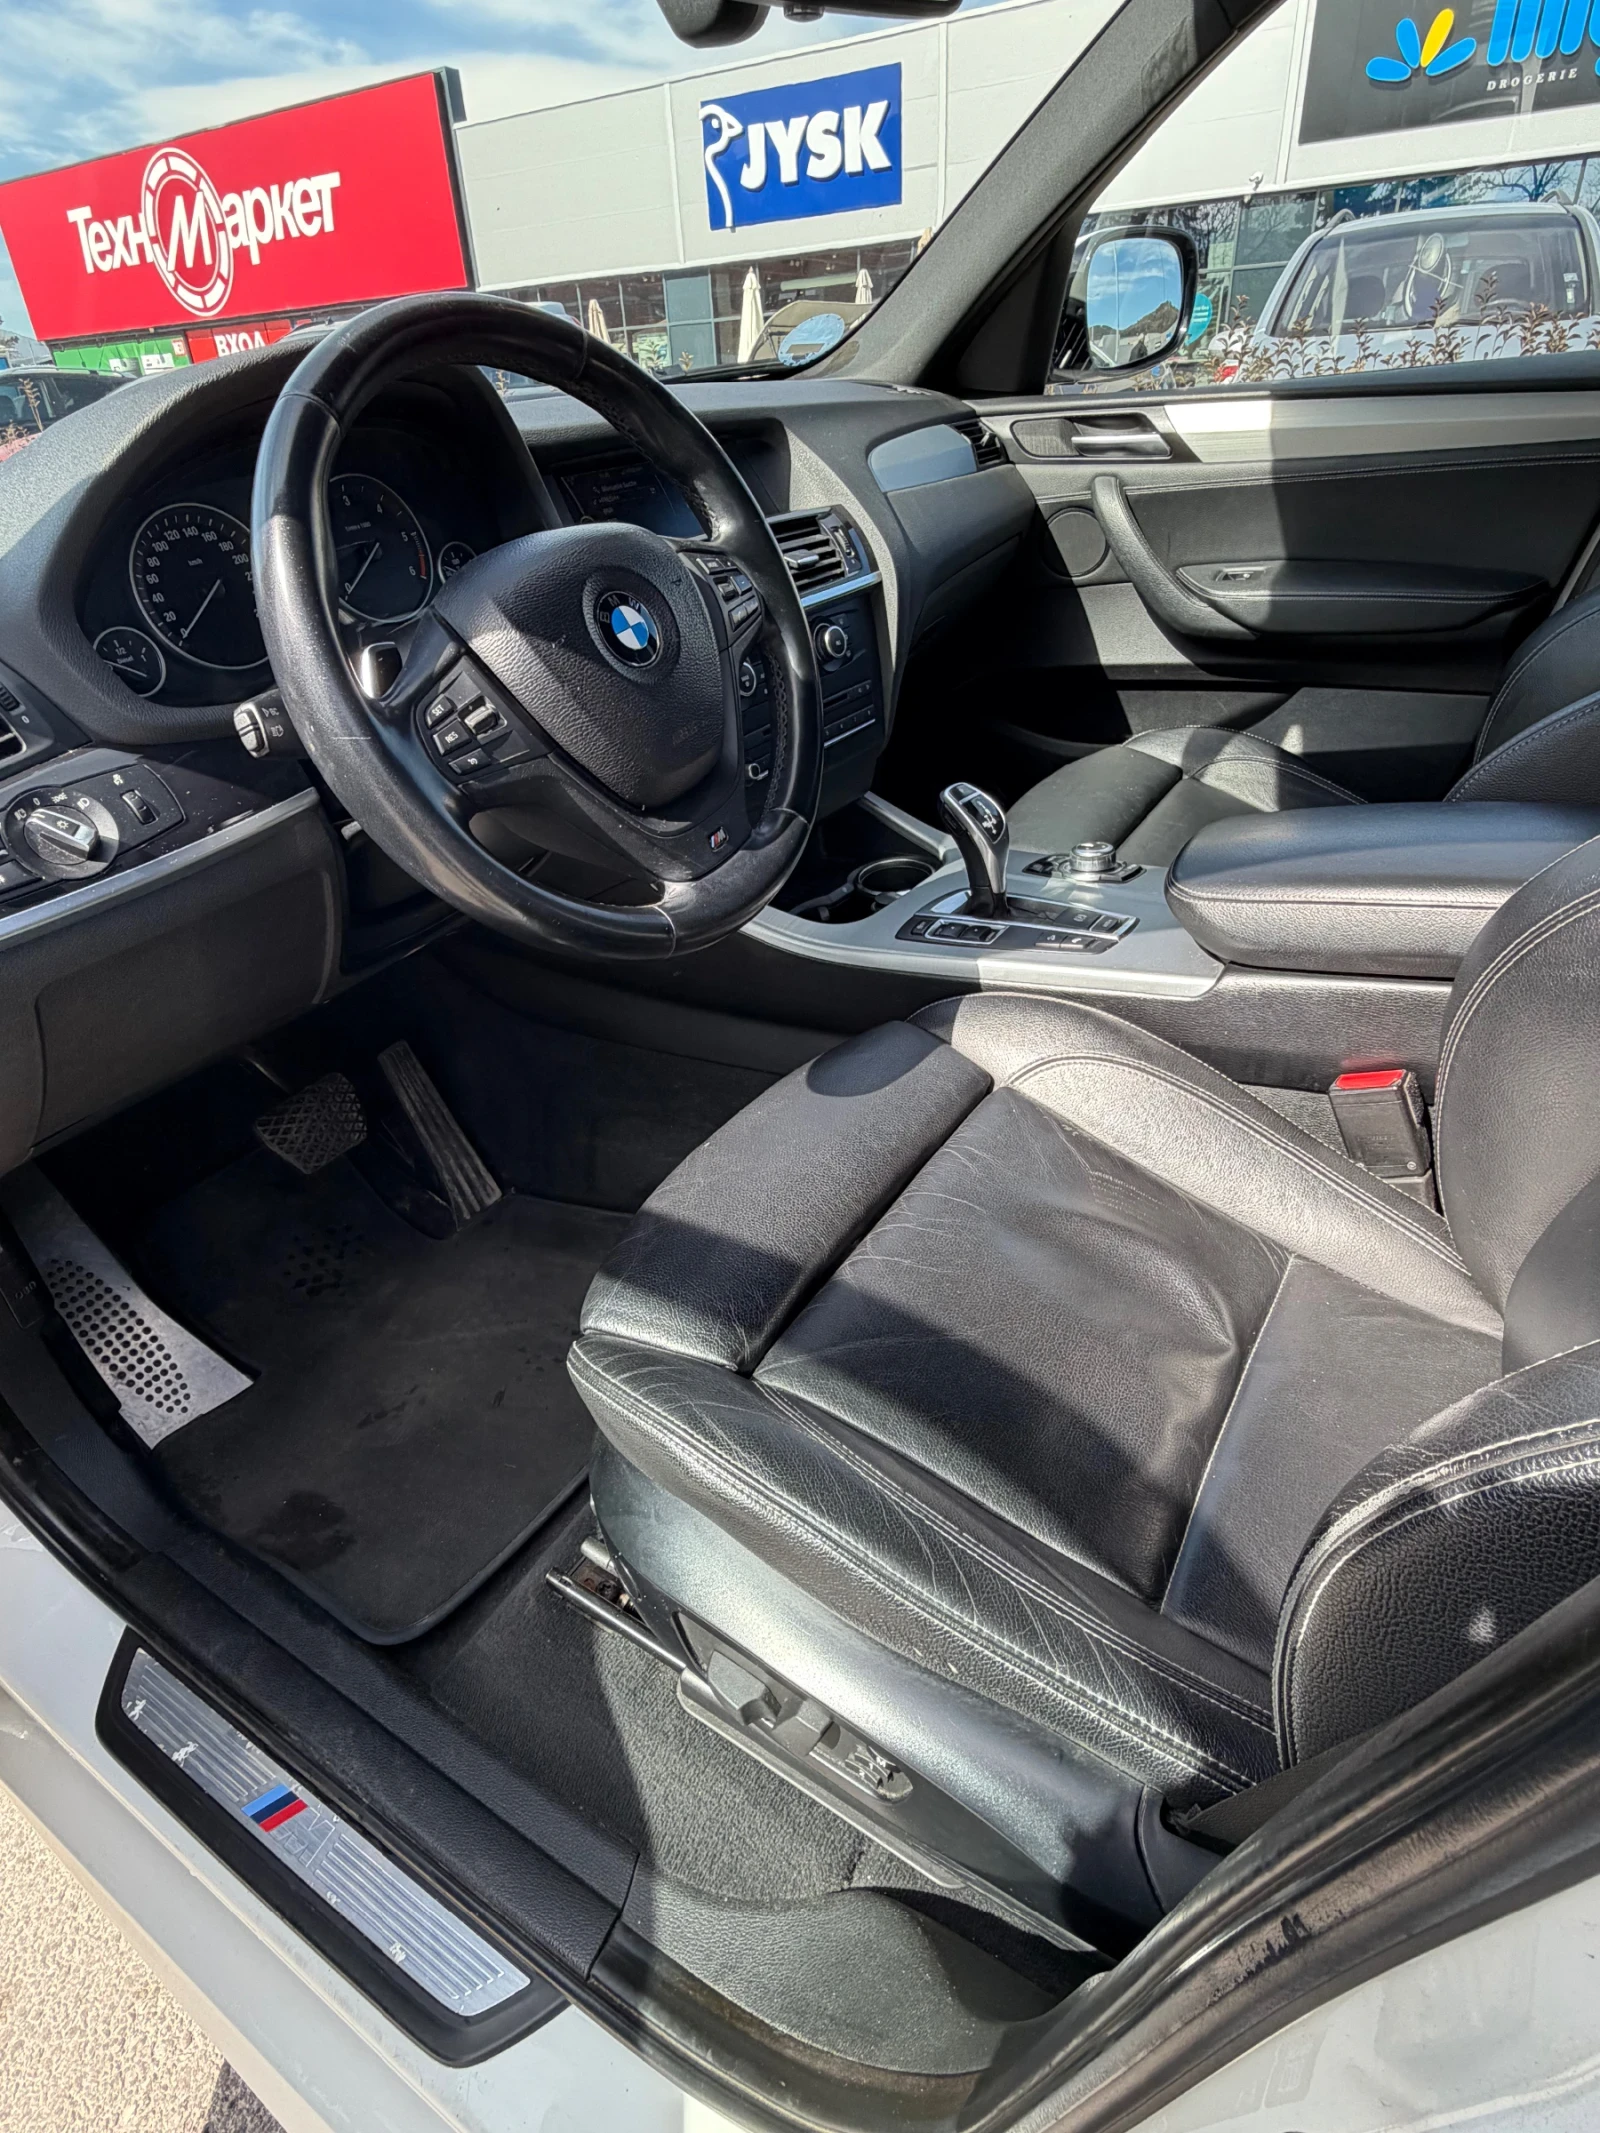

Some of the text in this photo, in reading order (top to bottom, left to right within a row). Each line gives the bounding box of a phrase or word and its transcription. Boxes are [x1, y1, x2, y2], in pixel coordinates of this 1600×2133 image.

[1486, 68, 1578, 91] DROGERIE
[740, 100, 892, 191] JYSK
[163, 530, 180, 541] 120
[181, 526, 199, 538] 140
[201, 530, 218, 543] 160
[400, 531, 409, 542] 5
[151, 540, 170, 553] 100
[218, 540, 234, 552] 180
[146, 556, 160, 568] 80
[231, 553, 249, 565] 200
[408, 565, 416, 576] 6
[146, 573, 160, 584] 60
[152, 592, 165, 603] 40
[600, 594, 640, 624] BMW
[163, 611, 177, 622] 20
[432, 704, 445, 716] SET
[445, 731, 459, 744] RES
